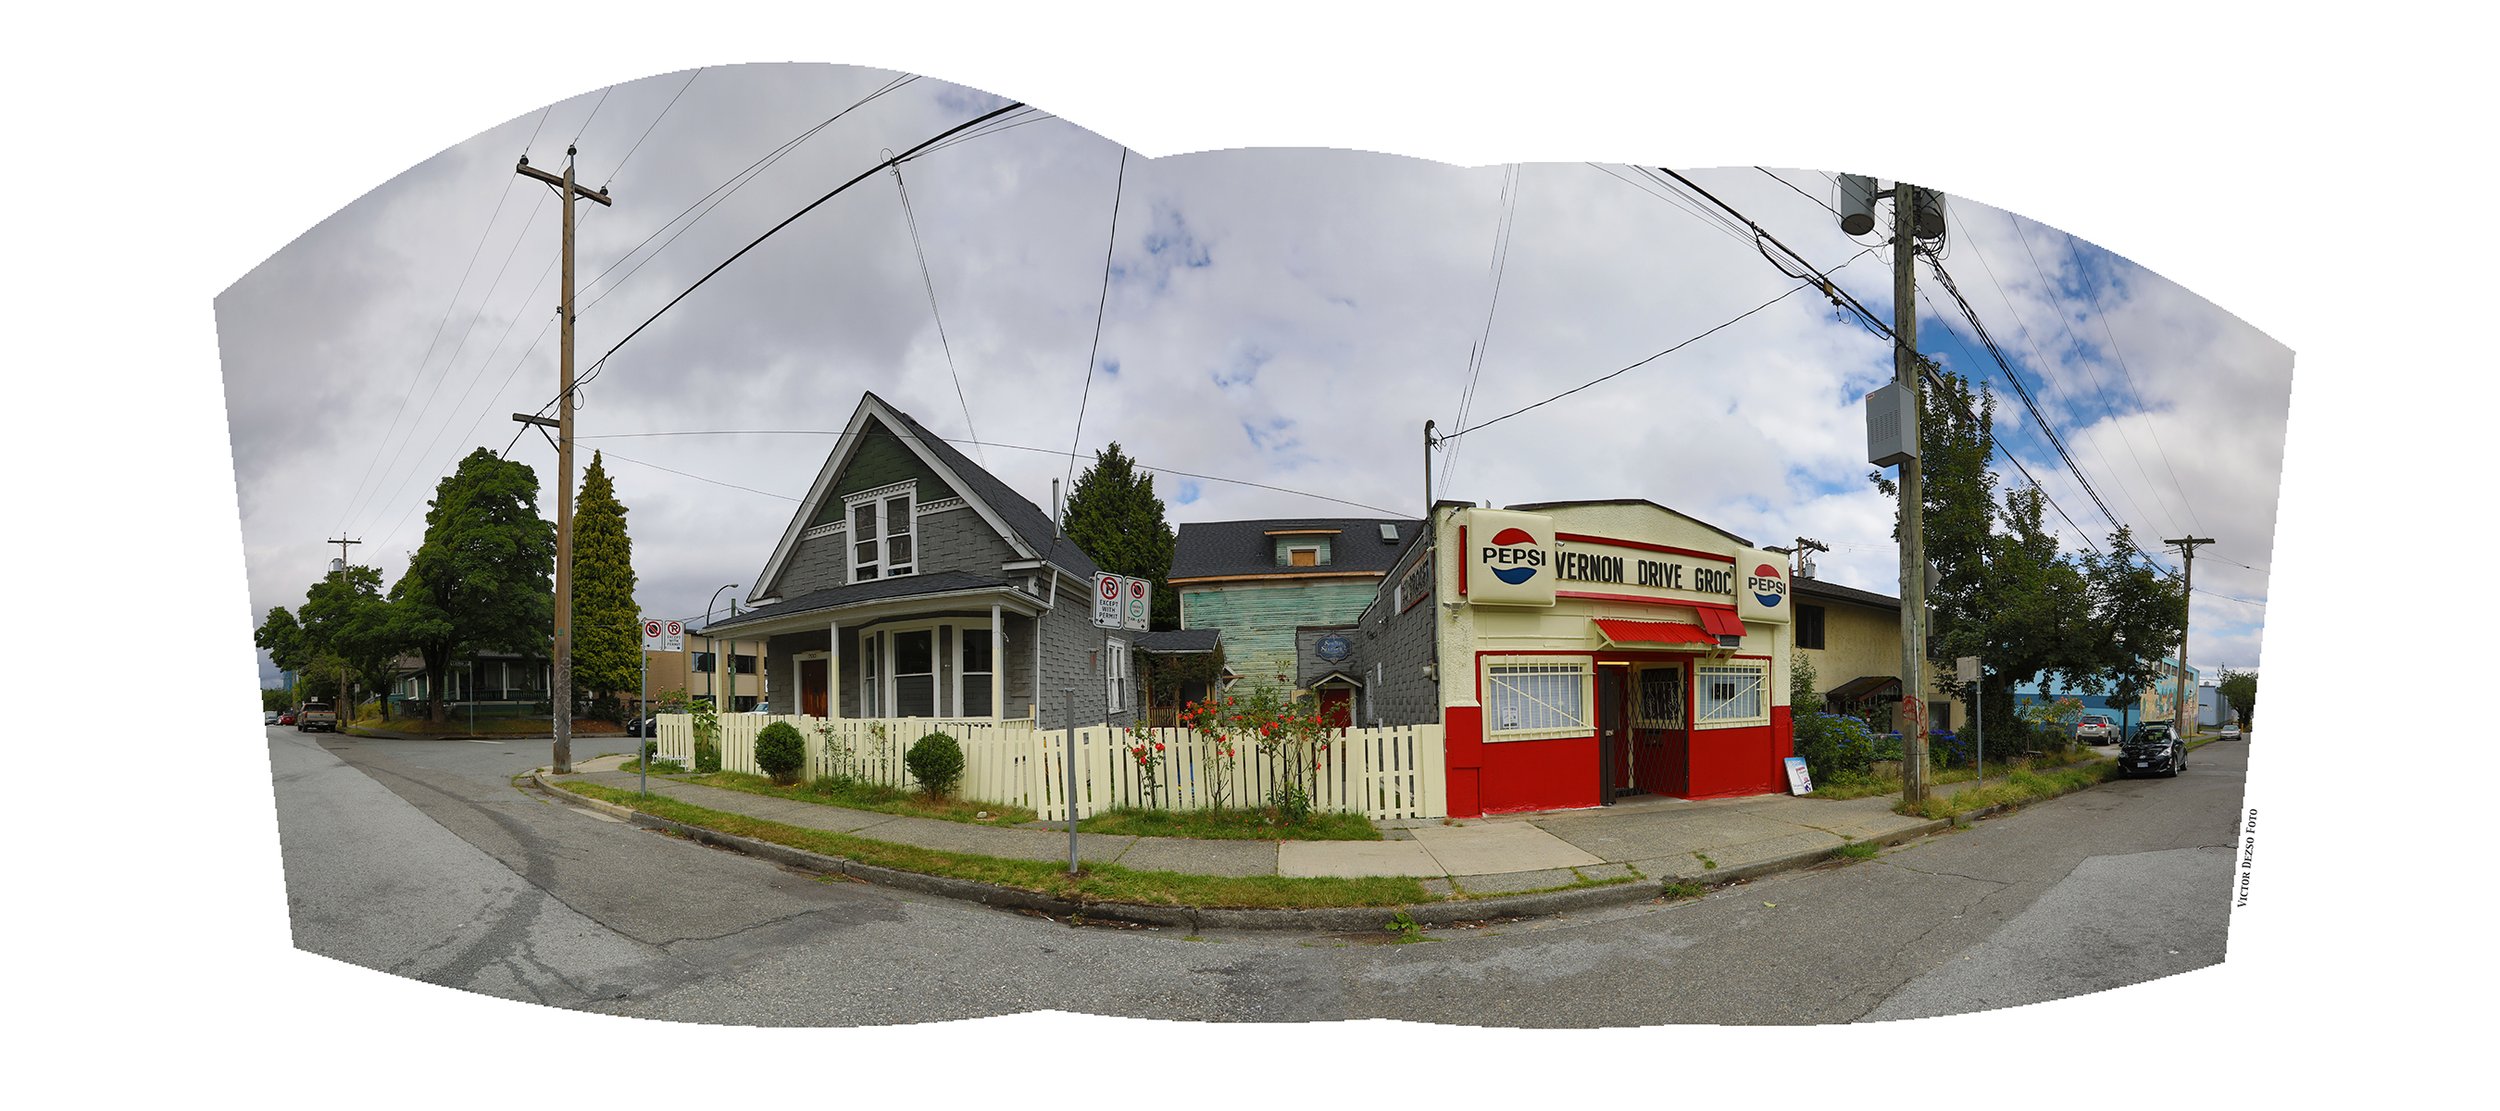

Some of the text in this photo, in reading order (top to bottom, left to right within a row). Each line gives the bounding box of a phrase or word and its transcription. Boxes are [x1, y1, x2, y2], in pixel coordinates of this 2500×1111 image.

[1482, 547, 1546, 566] PEPSI
[1555, 551, 1732, 595] VERNON DRIVE GROC
[1748, 576, 1787, 595] PEPSI
[1099, 599, 1119, 607] EXCEPT
[1098, 611, 1118, 619] PERMIT
